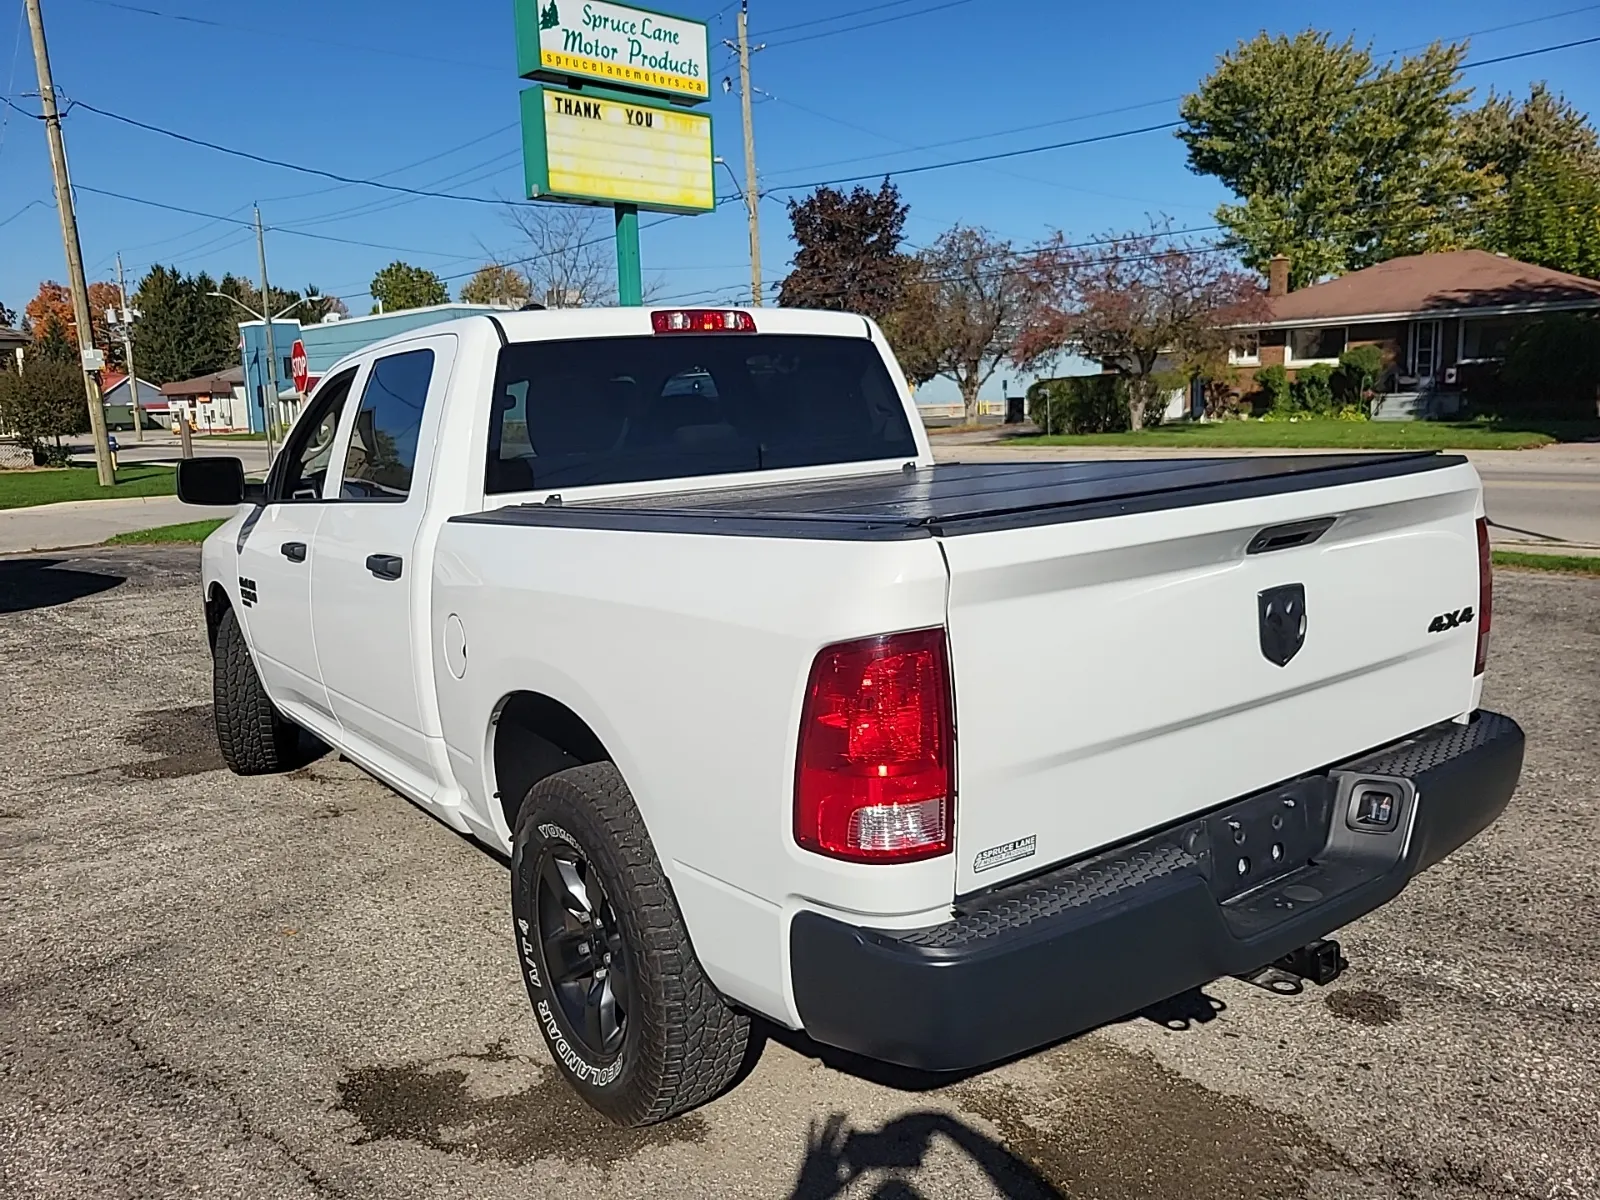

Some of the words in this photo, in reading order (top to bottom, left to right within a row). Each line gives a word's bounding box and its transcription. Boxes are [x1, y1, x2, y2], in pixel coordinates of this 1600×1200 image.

[582, 4, 636, 35] Spruce
[640, 18, 680, 45] Lane
[546, 53, 702, 92] sprucelanemotors.ca
[562, 29, 618, 60] Motor
[628, 37, 699, 77] Products
[555, 97, 602, 120] THANK
[625, 108, 653, 128] YOU
[293, 356, 306, 378] STOP
[982, 843, 1015, 859] SPRUCE
[1015, 836, 1035, 849] LANE
[537, 999, 623, 1087] GEOLANDAR
